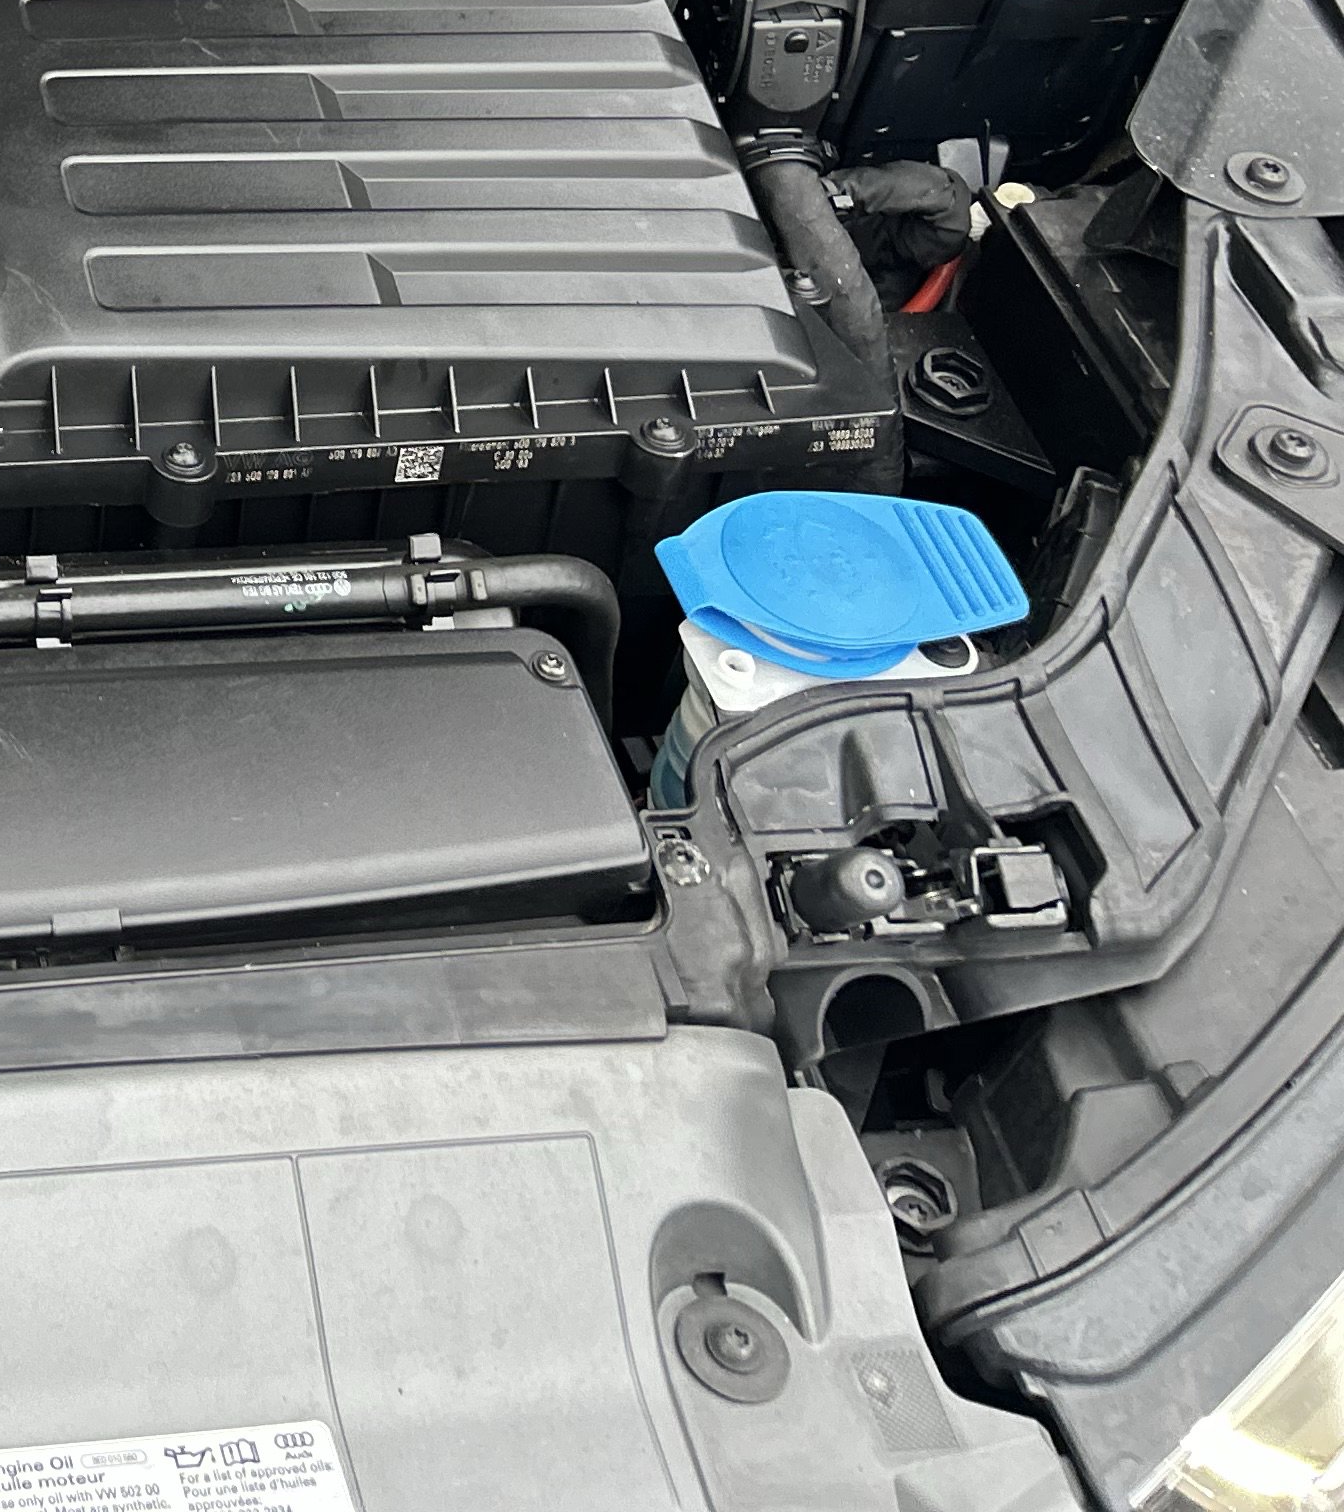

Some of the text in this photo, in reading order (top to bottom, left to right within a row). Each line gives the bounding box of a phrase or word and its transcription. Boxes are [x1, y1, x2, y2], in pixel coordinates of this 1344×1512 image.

[49, 1454, 74, 1471] Oil
[178, 1472, 201, 1486] For
[203, 1472, 212, 1484] a
[213, 1468, 233, 1482] list
[234, 1467, 247, 1480] of
[249, 1462, 308, 1480] approved
[38, 1471, 106, 1490] moteur
[182, 1475, 318, 1500] Pour une liste d'huiles
[18, 1493, 44, 1510] only
[47, 1491, 63, 1506] oil
[65, 1489, 93, 1504] with
[95, 1486, 117, 1501] VW
[119, 1483, 143, 1499] 502
[144, 1482, 161, 1497] 00
